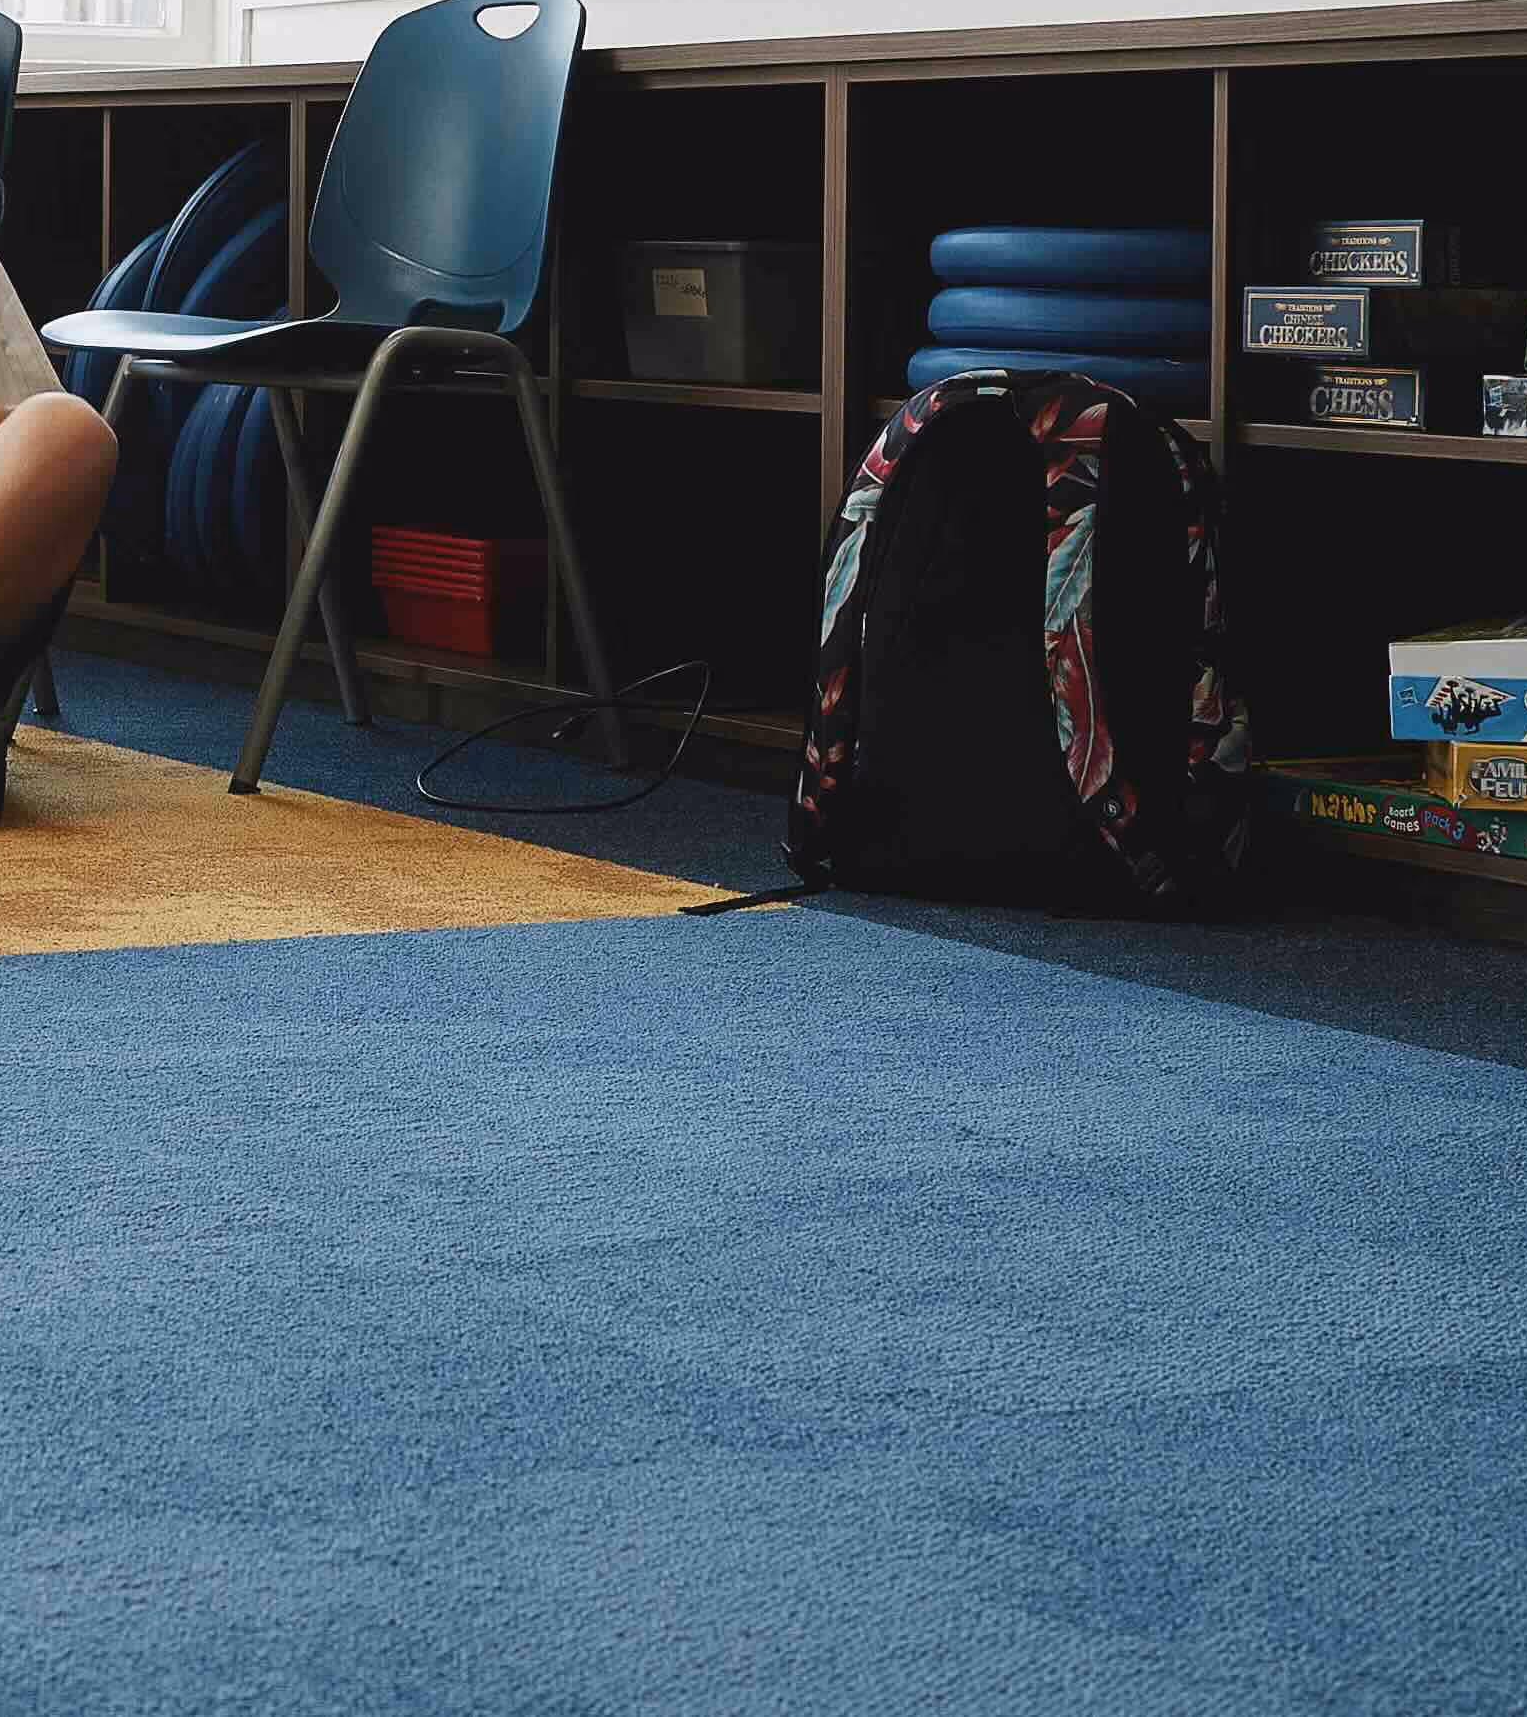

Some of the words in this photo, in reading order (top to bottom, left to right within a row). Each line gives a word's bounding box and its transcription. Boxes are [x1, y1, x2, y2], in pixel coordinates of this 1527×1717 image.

[1309, 250, 1408, 276] CHECKERS
[1259, 324, 1349, 348] CHECKERS
[1309, 386, 1394, 420] CHESS
[1382, 814, 1421, 833] Games
[1452, 820, 1467, 840] 3
